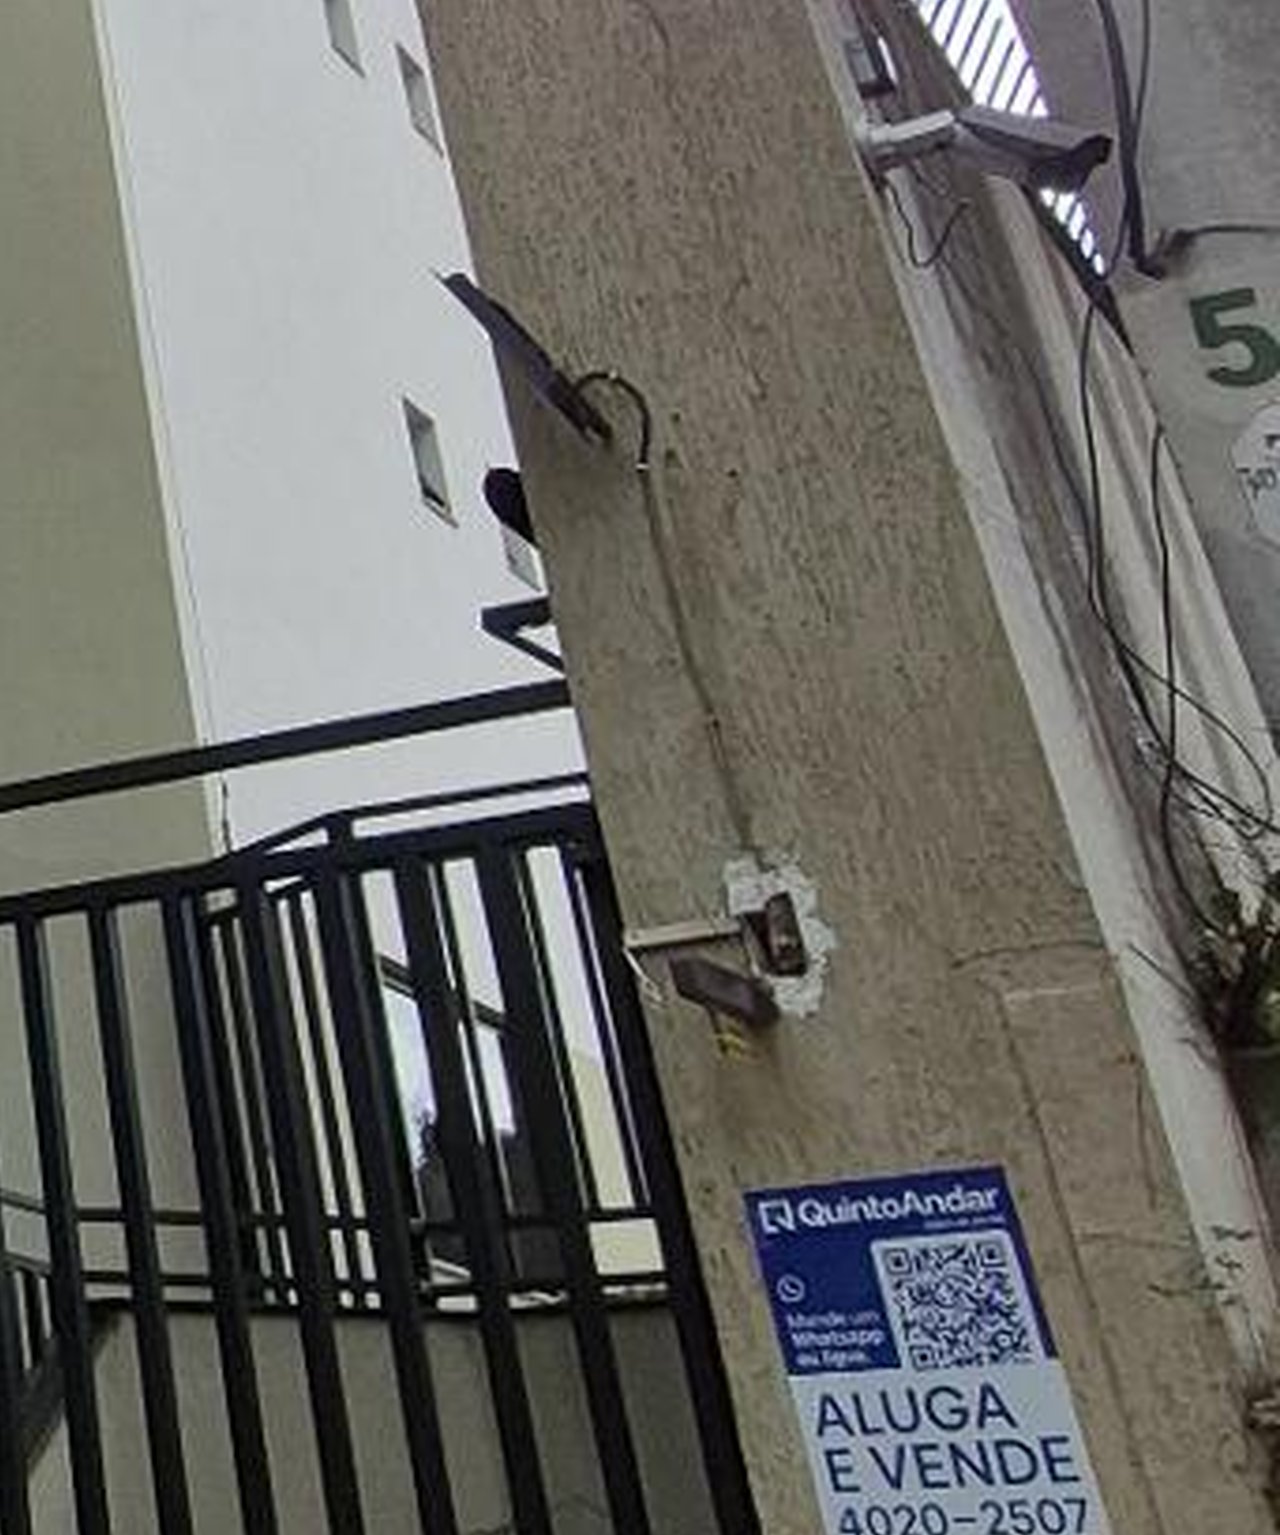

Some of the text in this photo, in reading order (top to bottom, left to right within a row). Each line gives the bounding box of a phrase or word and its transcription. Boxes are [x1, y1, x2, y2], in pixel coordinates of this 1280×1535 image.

[797, 1184, 999, 1227] QuintoAndar
[816, 1384, 1017, 1437] ALUGA
[826, 1436, 1081, 1493] E VENDE
